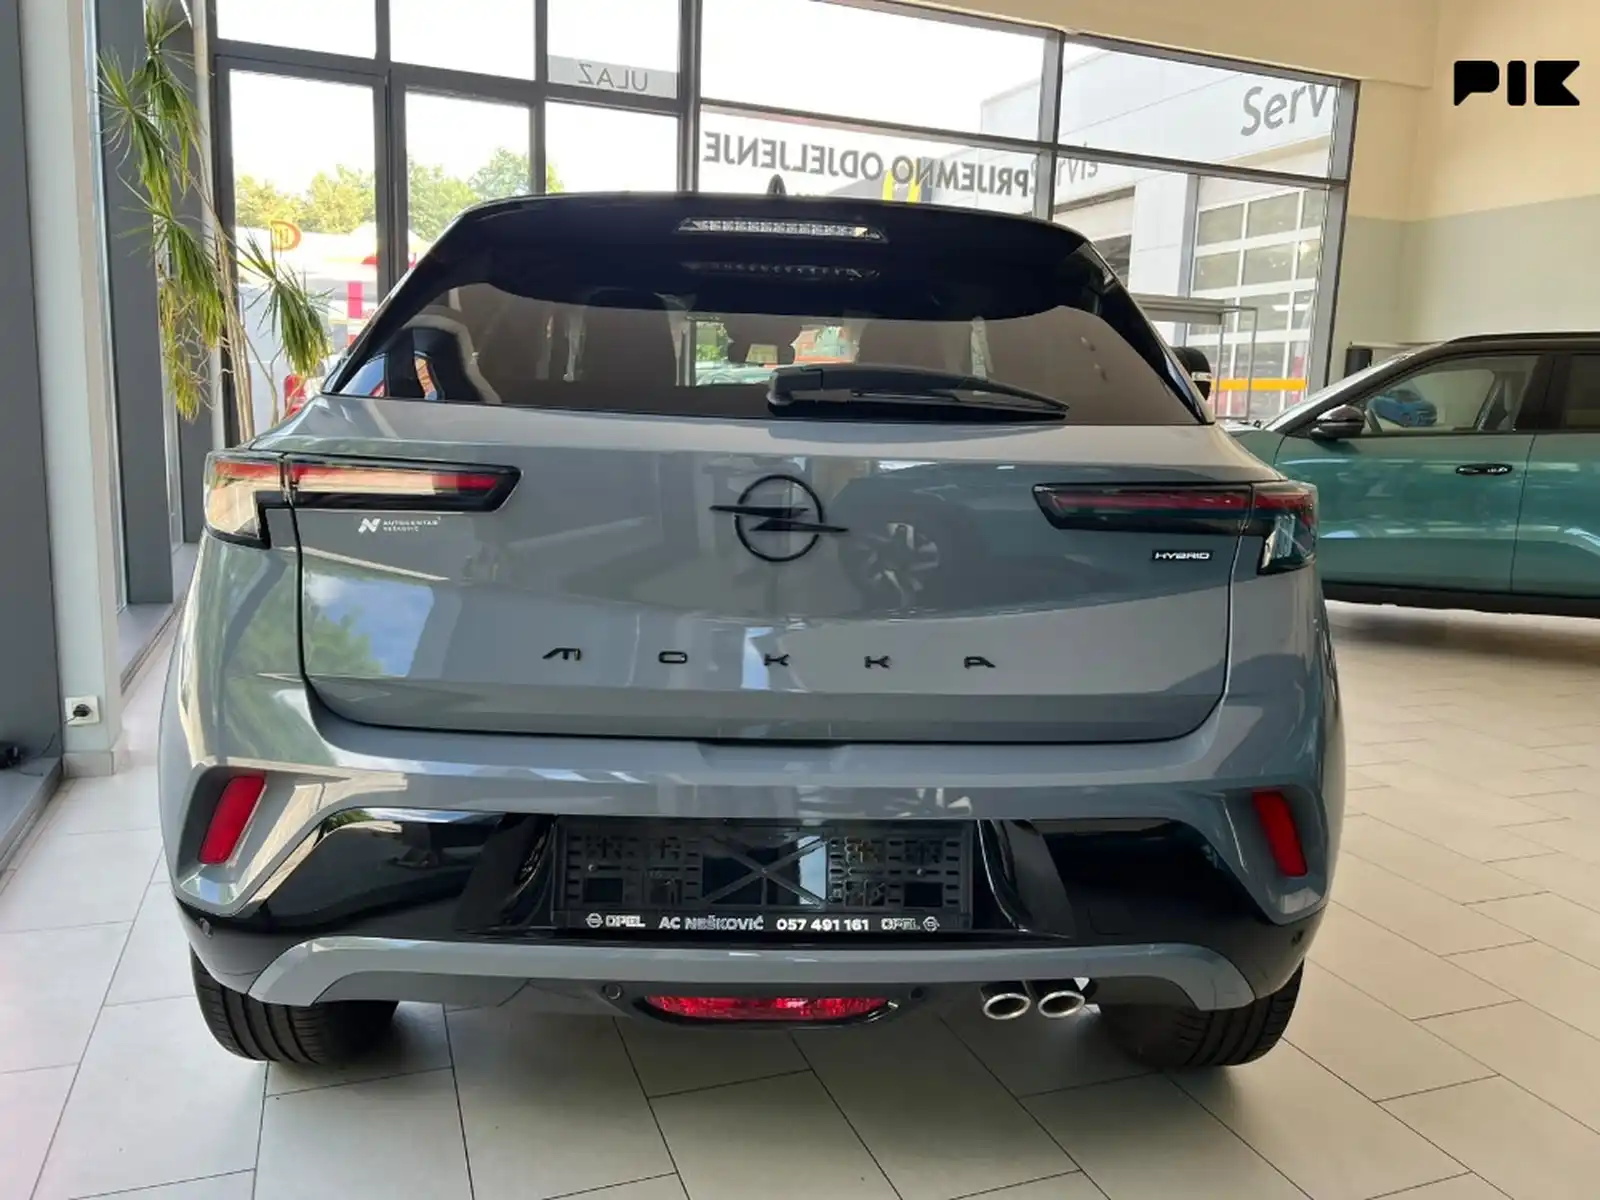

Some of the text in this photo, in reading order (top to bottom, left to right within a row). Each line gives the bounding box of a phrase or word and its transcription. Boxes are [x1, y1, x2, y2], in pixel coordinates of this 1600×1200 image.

[1155, 552, 1210, 560] HYBRID
[542, 648, 996, 669] MOKKA
[605, 915, 646, 928] OPEL
[658, 916, 681, 930] AC
[685, 915, 765, 931] NEŠKOVIĆ
[776, 918, 807, 931] 057
[811, 918, 840, 931] 491
